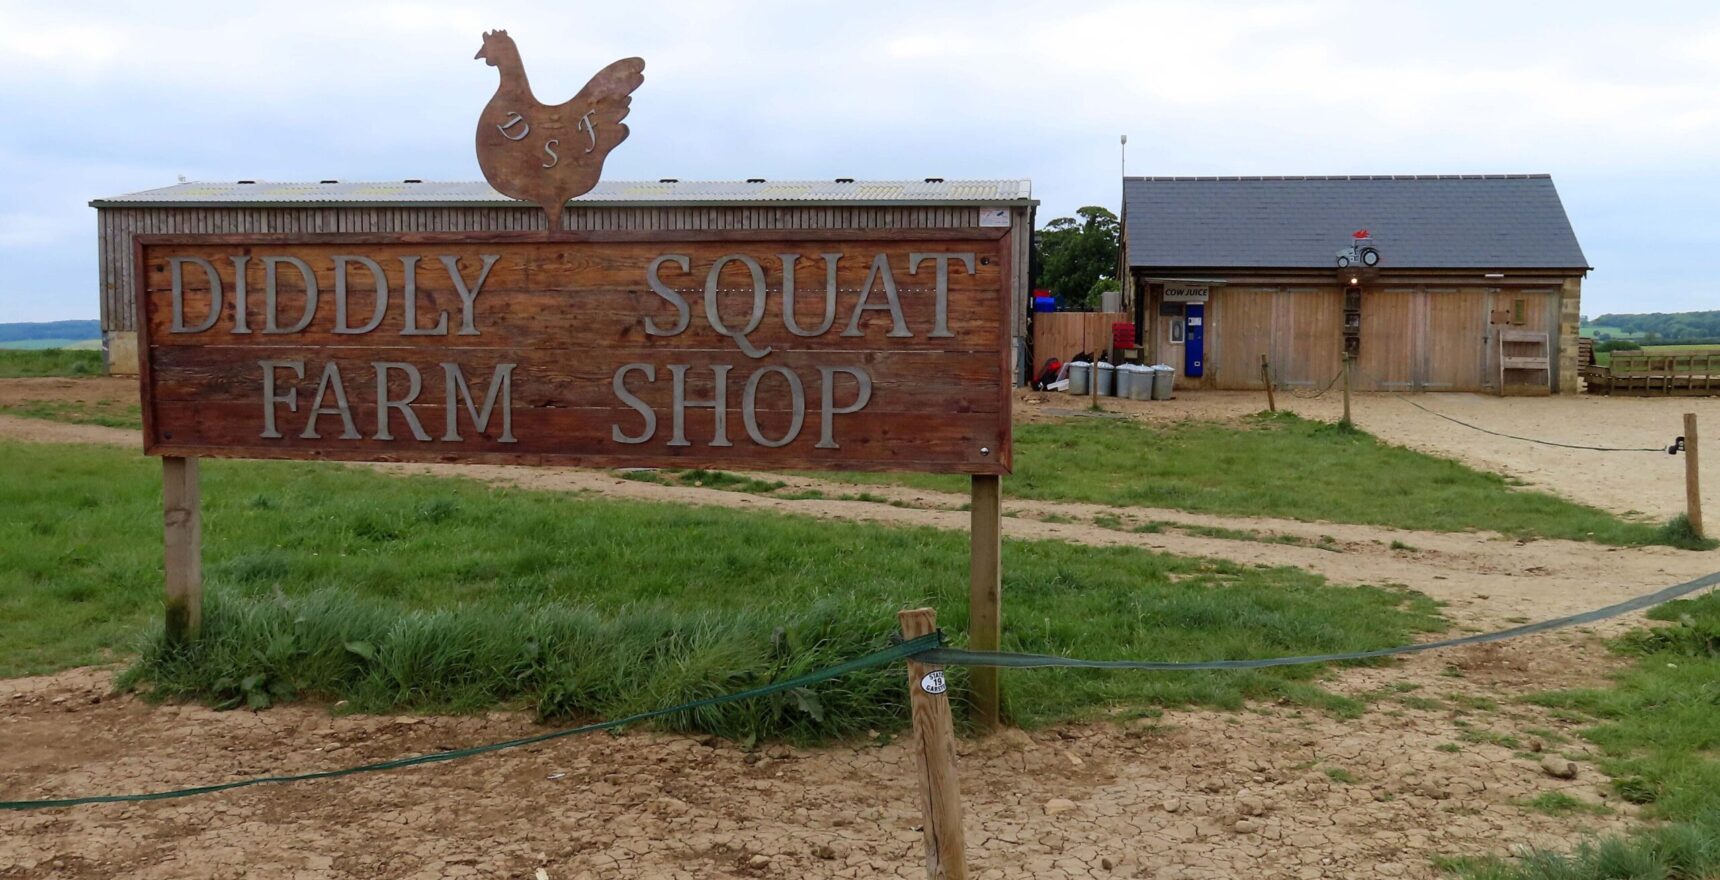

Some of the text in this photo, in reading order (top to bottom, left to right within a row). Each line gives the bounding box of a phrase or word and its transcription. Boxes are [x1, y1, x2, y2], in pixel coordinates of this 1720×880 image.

[496, 111, 530, 141] D
[542, 139, 560, 169] S
[167, 252, 977, 359] DIDDLY SQUAT
[1165, 288, 1208, 296] COW JUICE
[258, 360, 873, 449] FARM SHOP
[933, 678, 942, 686] 19
